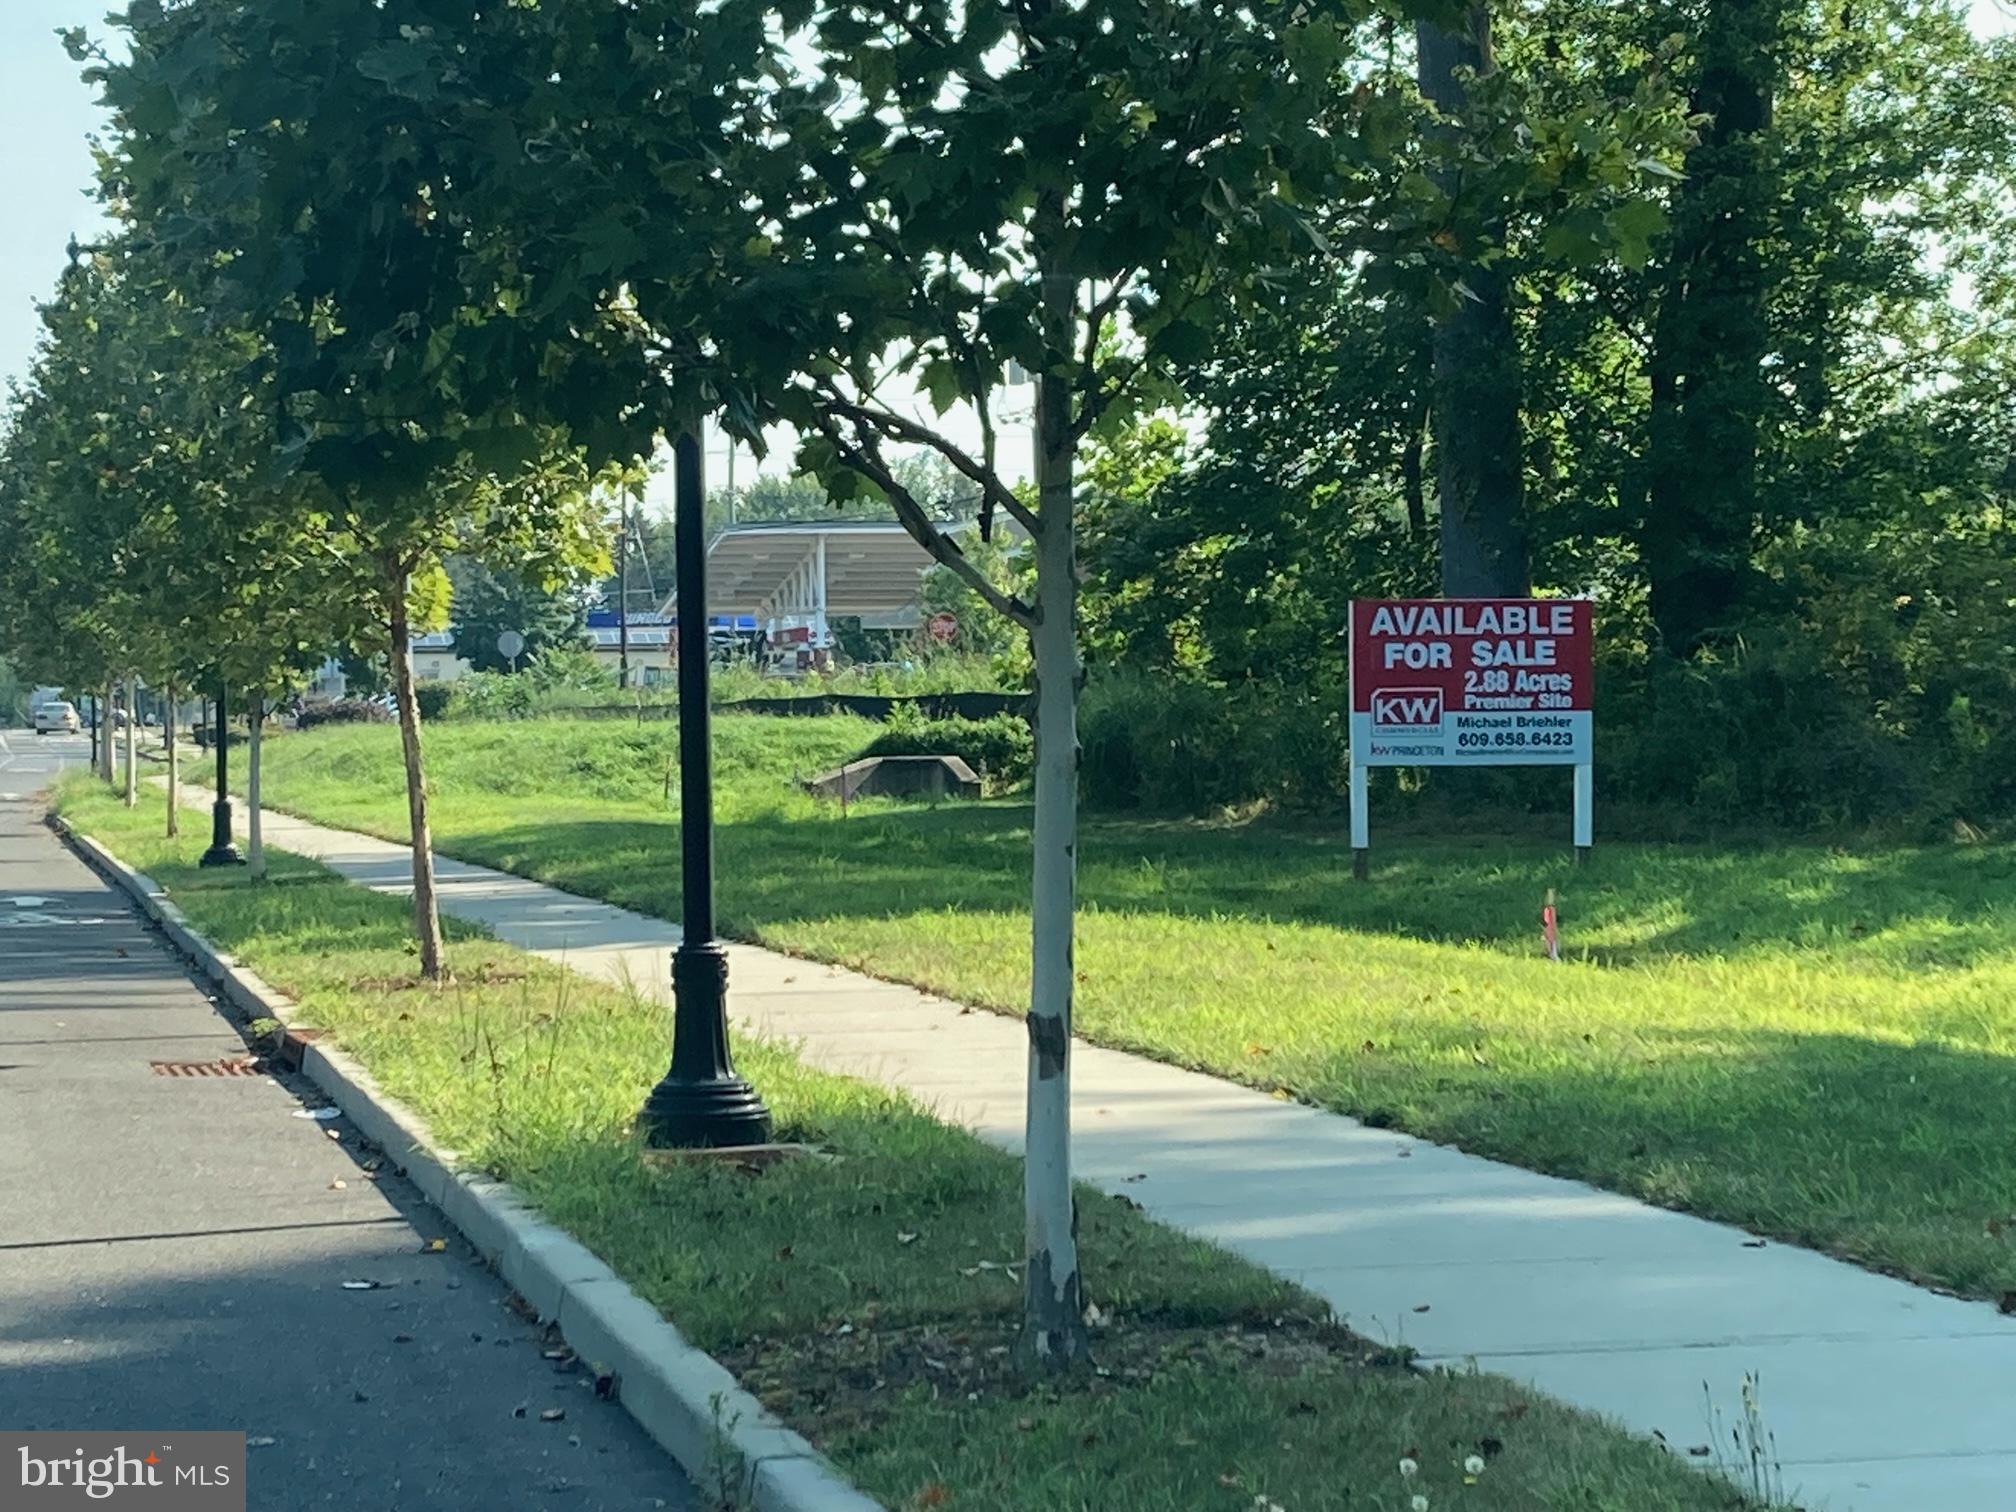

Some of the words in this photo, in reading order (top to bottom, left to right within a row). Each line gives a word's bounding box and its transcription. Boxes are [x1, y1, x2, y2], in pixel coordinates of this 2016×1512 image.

[1370, 606, 1574, 635] AVAILABLE
[1384, 642, 1453, 669] FOR
[1472, 640, 1557, 666] SALE
[1464, 670, 1510, 693] 2.88
[1515, 670, 1572, 691] Acres
[1376, 697, 1438, 724] KW
[1464, 694, 1534, 710] Premier
[1538, 692, 1573, 709] Site
[1457, 717, 1512, 728] Michael
[1458, 732, 1574, 747] 609.658.6423
